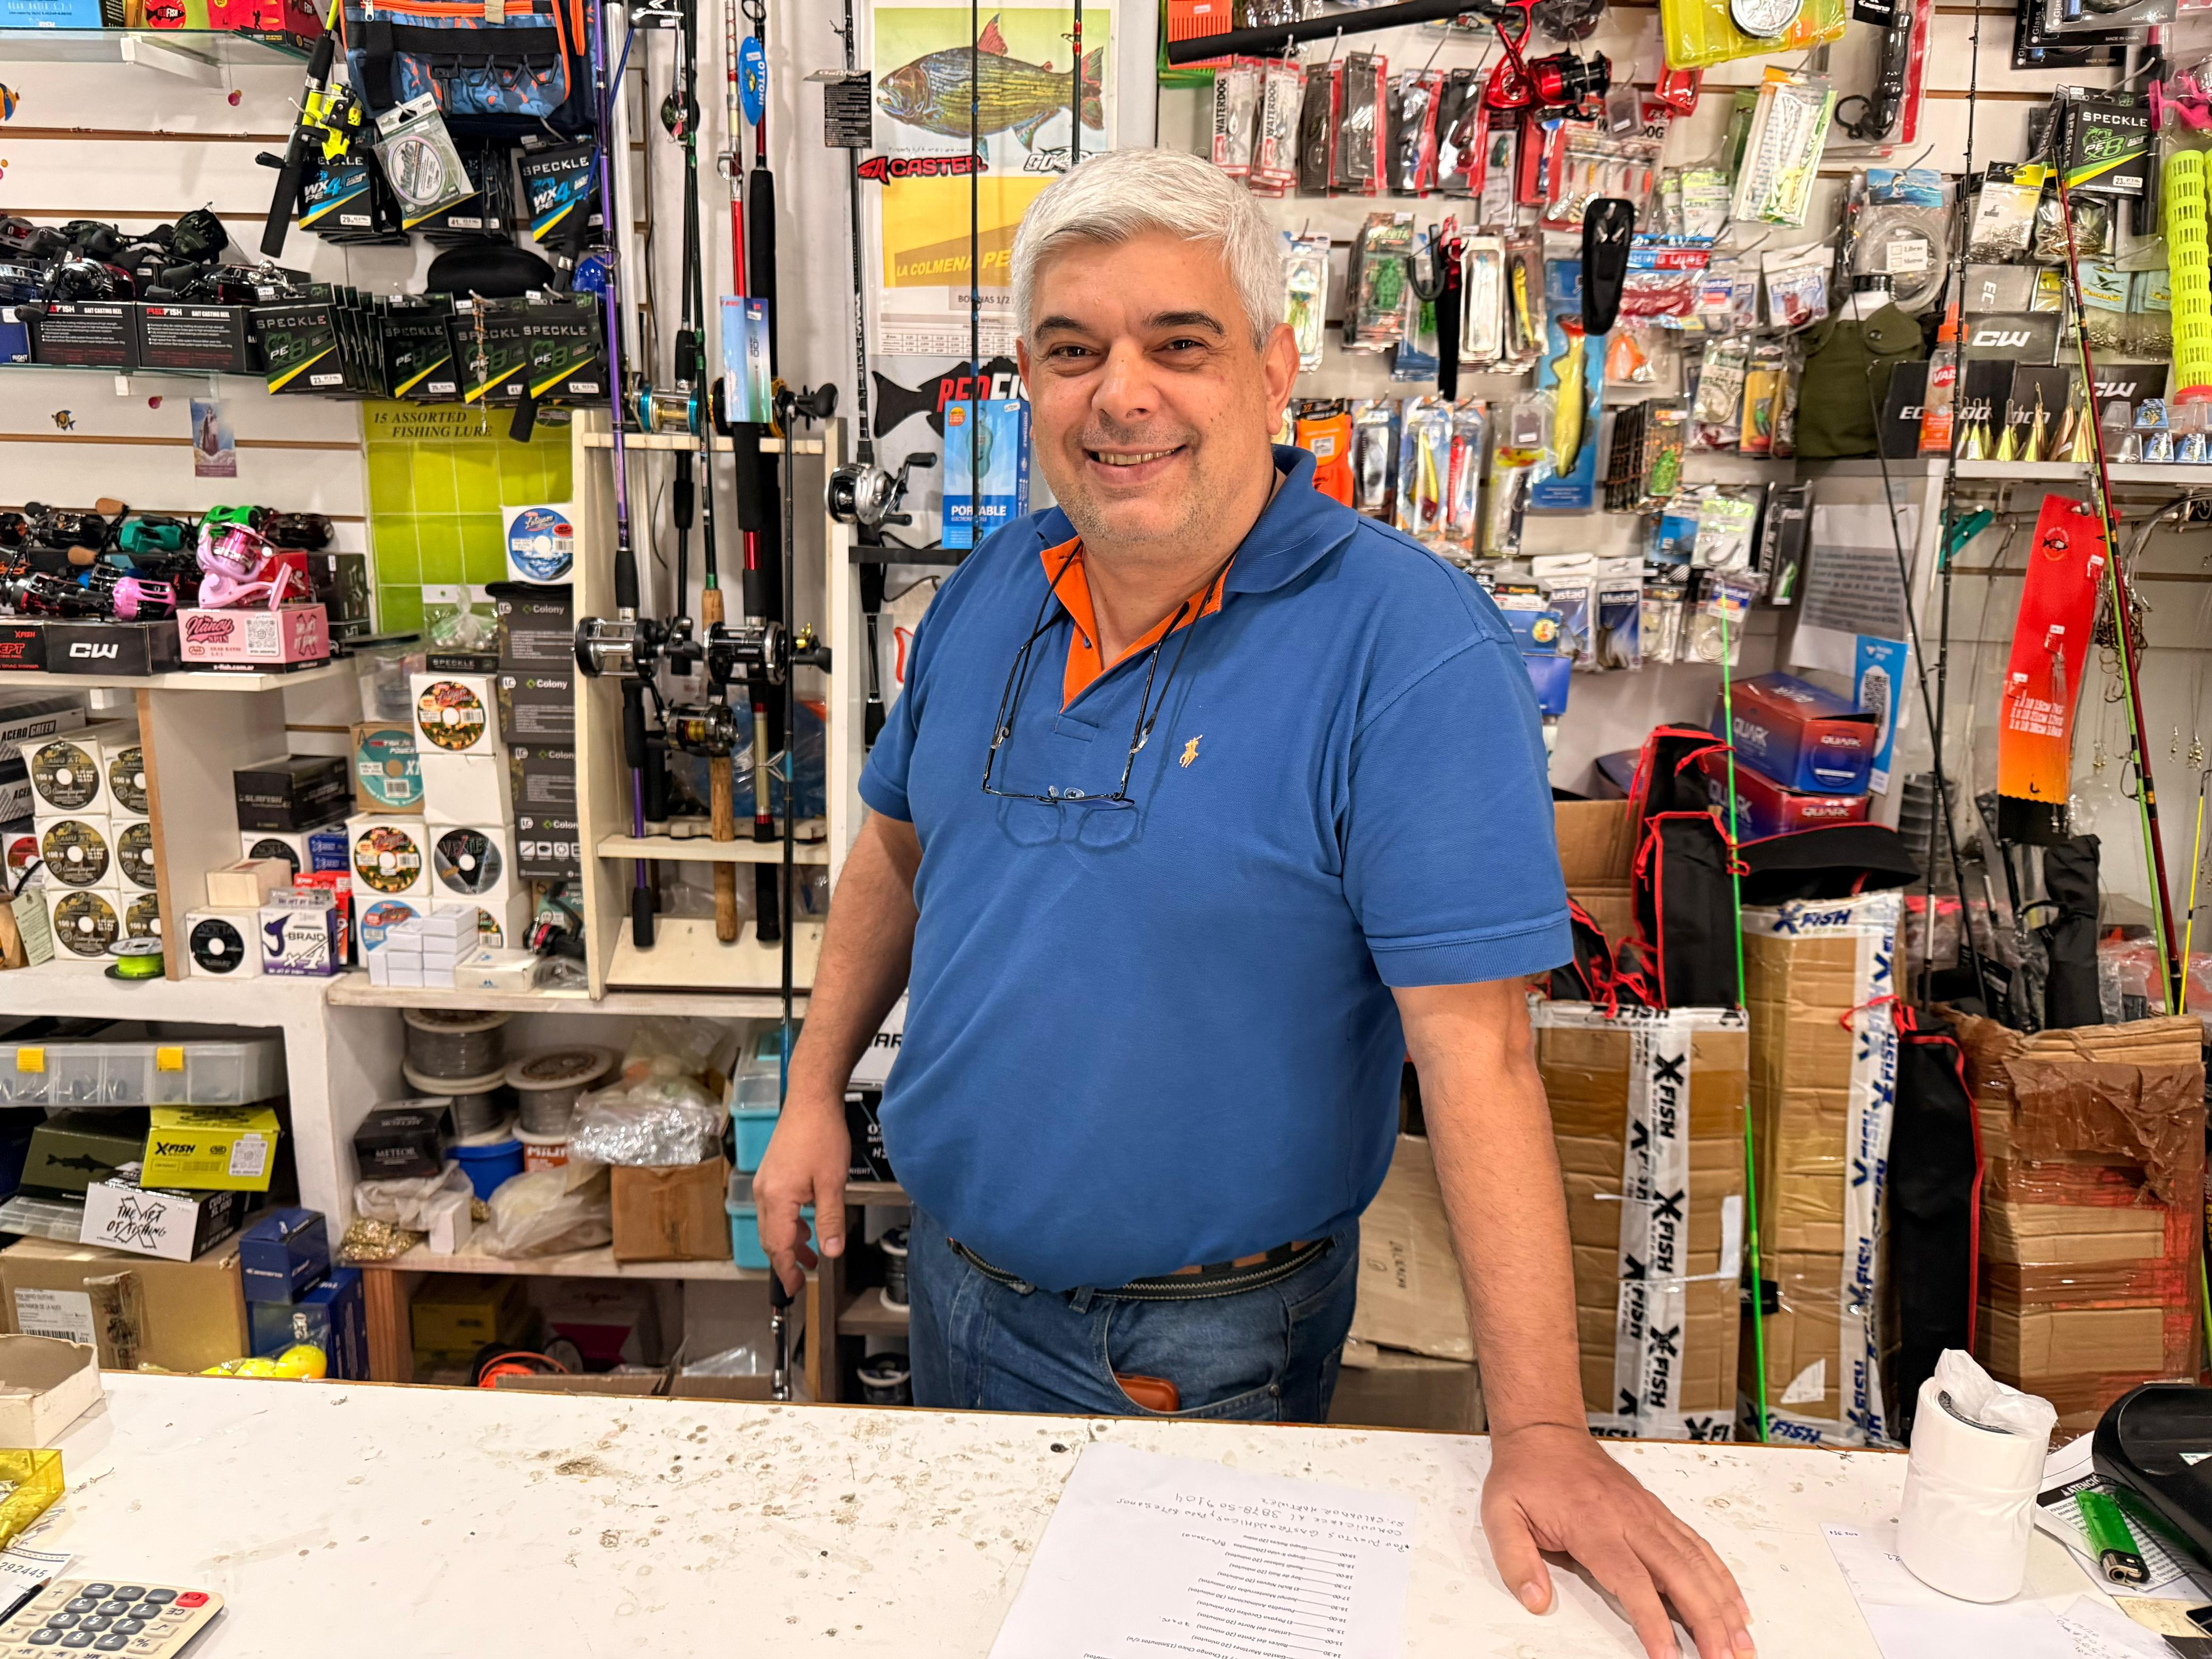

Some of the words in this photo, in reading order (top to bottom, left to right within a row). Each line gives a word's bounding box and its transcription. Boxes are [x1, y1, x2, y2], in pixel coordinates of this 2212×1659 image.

[2032, 11, 2041, 35] Glass
[1215, 78, 1227, 134] WATERDOG
[1266, 80, 1276, 137] WATERDOG
[2082, 111, 2148, 128] SPECKLE
[2084, 141, 2105, 154] PE
[522, 156, 589, 177] SPECKLE
[305, 190, 324, 203] PE
[535, 202, 553, 214] PE
[896, 266, 908, 277] LA
[910, 255, 974, 276] COLMENA
[982, 249, 1012, 270] PE
[257, 315, 326, 329] SPECKLE
[386, 325, 443, 337] SPECKLE
[458, 329, 519, 342] SPECKL
[523, 325, 588, 337] SPECKLE
[1972, 330, 2032, 348] CW
[270, 345, 289, 361] PE
[395, 352, 413, 367] PE
[534, 353, 552, 367] PE
[374, 412, 388, 424] 15
[392, 411, 467, 424] ASSORTED
[392, 426, 451, 438] FISHING
[454, 425, 493, 438] LURE
[951, 505, 1007, 517] PORABLE
[1601, 592, 1638, 604] Mustad
[533, 605, 565, 615] Colony
[186, 615, 235, 635] Nancy
[69, 642, 119, 659] CW
[432, 658, 475, 668] SPECKLE
[536, 678, 568, 690] Colony
[1, 727, 27, 741] ACERO
[29, 720, 56, 738] GREEN
[1820, 735, 1862, 747] QUARK
[1801, 807, 1850, 818] QUARK
[552, 820, 579, 831] Colon
[375, 1147, 417, 1158] METEOR
[118, 1205, 137, 1220] THE
[139, 1209, 162, 1224] ART
[107, 1220, 121, 1233] OF
[125, 1221, 167, 1237] FISHING
[2067, 1475, 2100, 1495] ATENCIÓ
[1229, 1562, 1256, 1572] minutos)
[1217, 1571, 1244, 1580] minutos)
[1197, 1577, 1225, 1587] minutos)
[1187, 1586, 1214, 1596] minutos)
[1196, 1599, 1224, 1610] minutos)
[1227, 1596, 1266, 1608] Animaciones
[1196, 1611, 1225, 1622] minutos)
[1263, 1614, 1286, 1623] Payaso
[1196, 1623, 1225, 1633] minutos)
[1268, 1627, 1291, 1636] Latidos
[1191, 1634, 1220, 1645] minutos)
